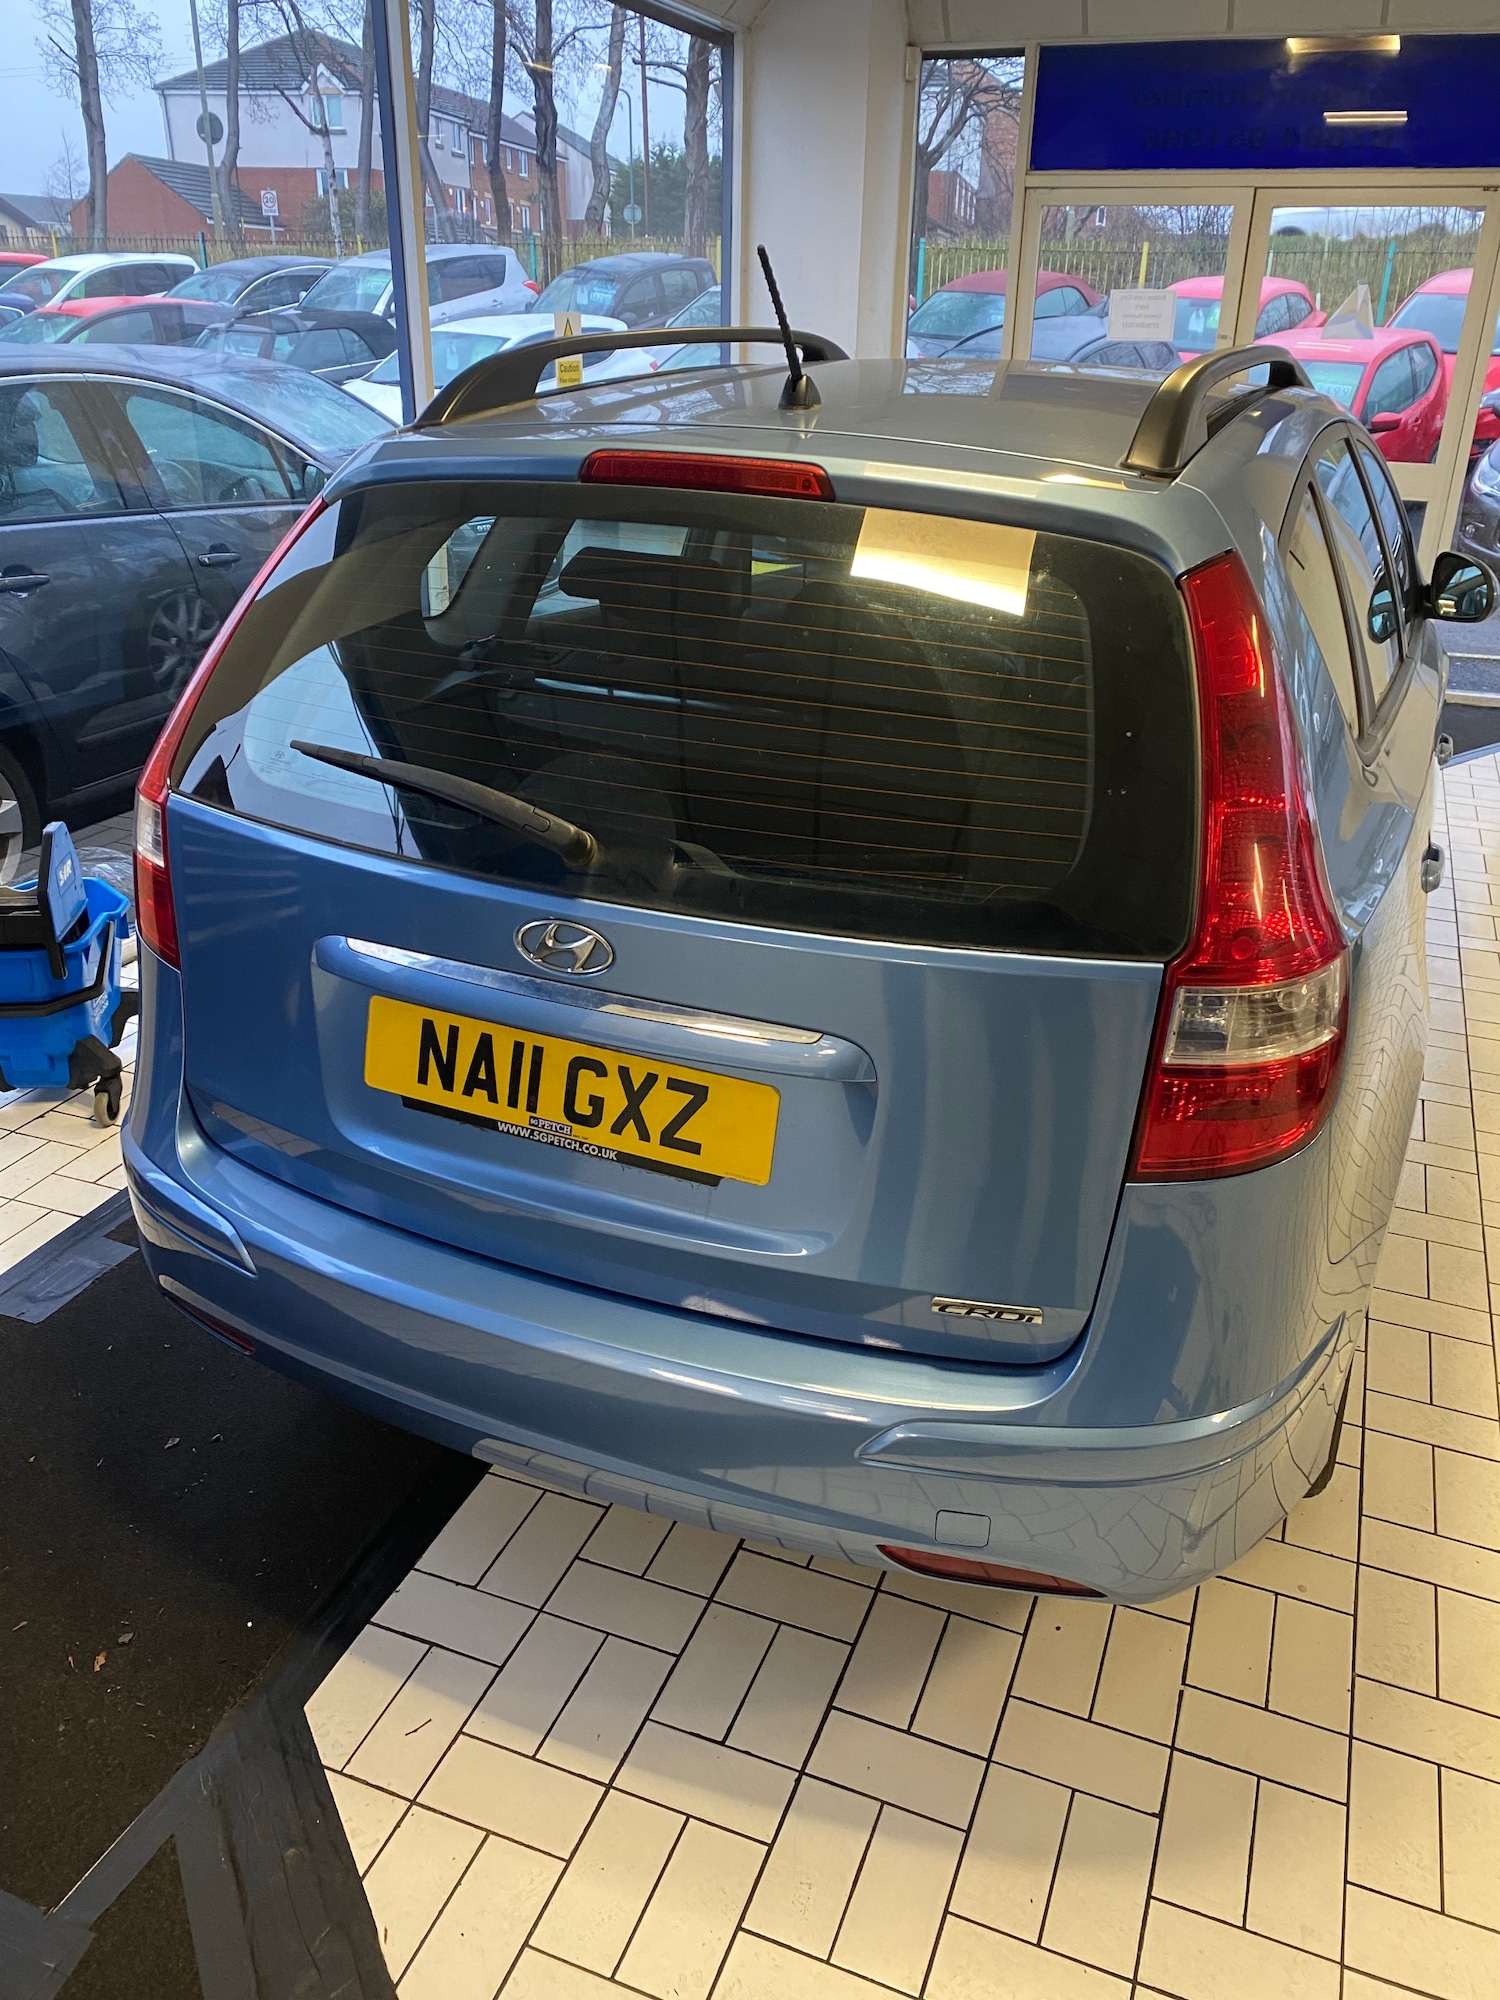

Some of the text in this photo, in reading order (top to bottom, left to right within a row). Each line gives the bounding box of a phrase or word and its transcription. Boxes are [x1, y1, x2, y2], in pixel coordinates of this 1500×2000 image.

[559, 363, 579, 373] Caution
[417, 1018, 710, 1155] NA11 GXZ
[497, 1121, 618, 1160] WWW.SGPETCH.CO.UK
[538, 1118, 571, 1135] PETCH
